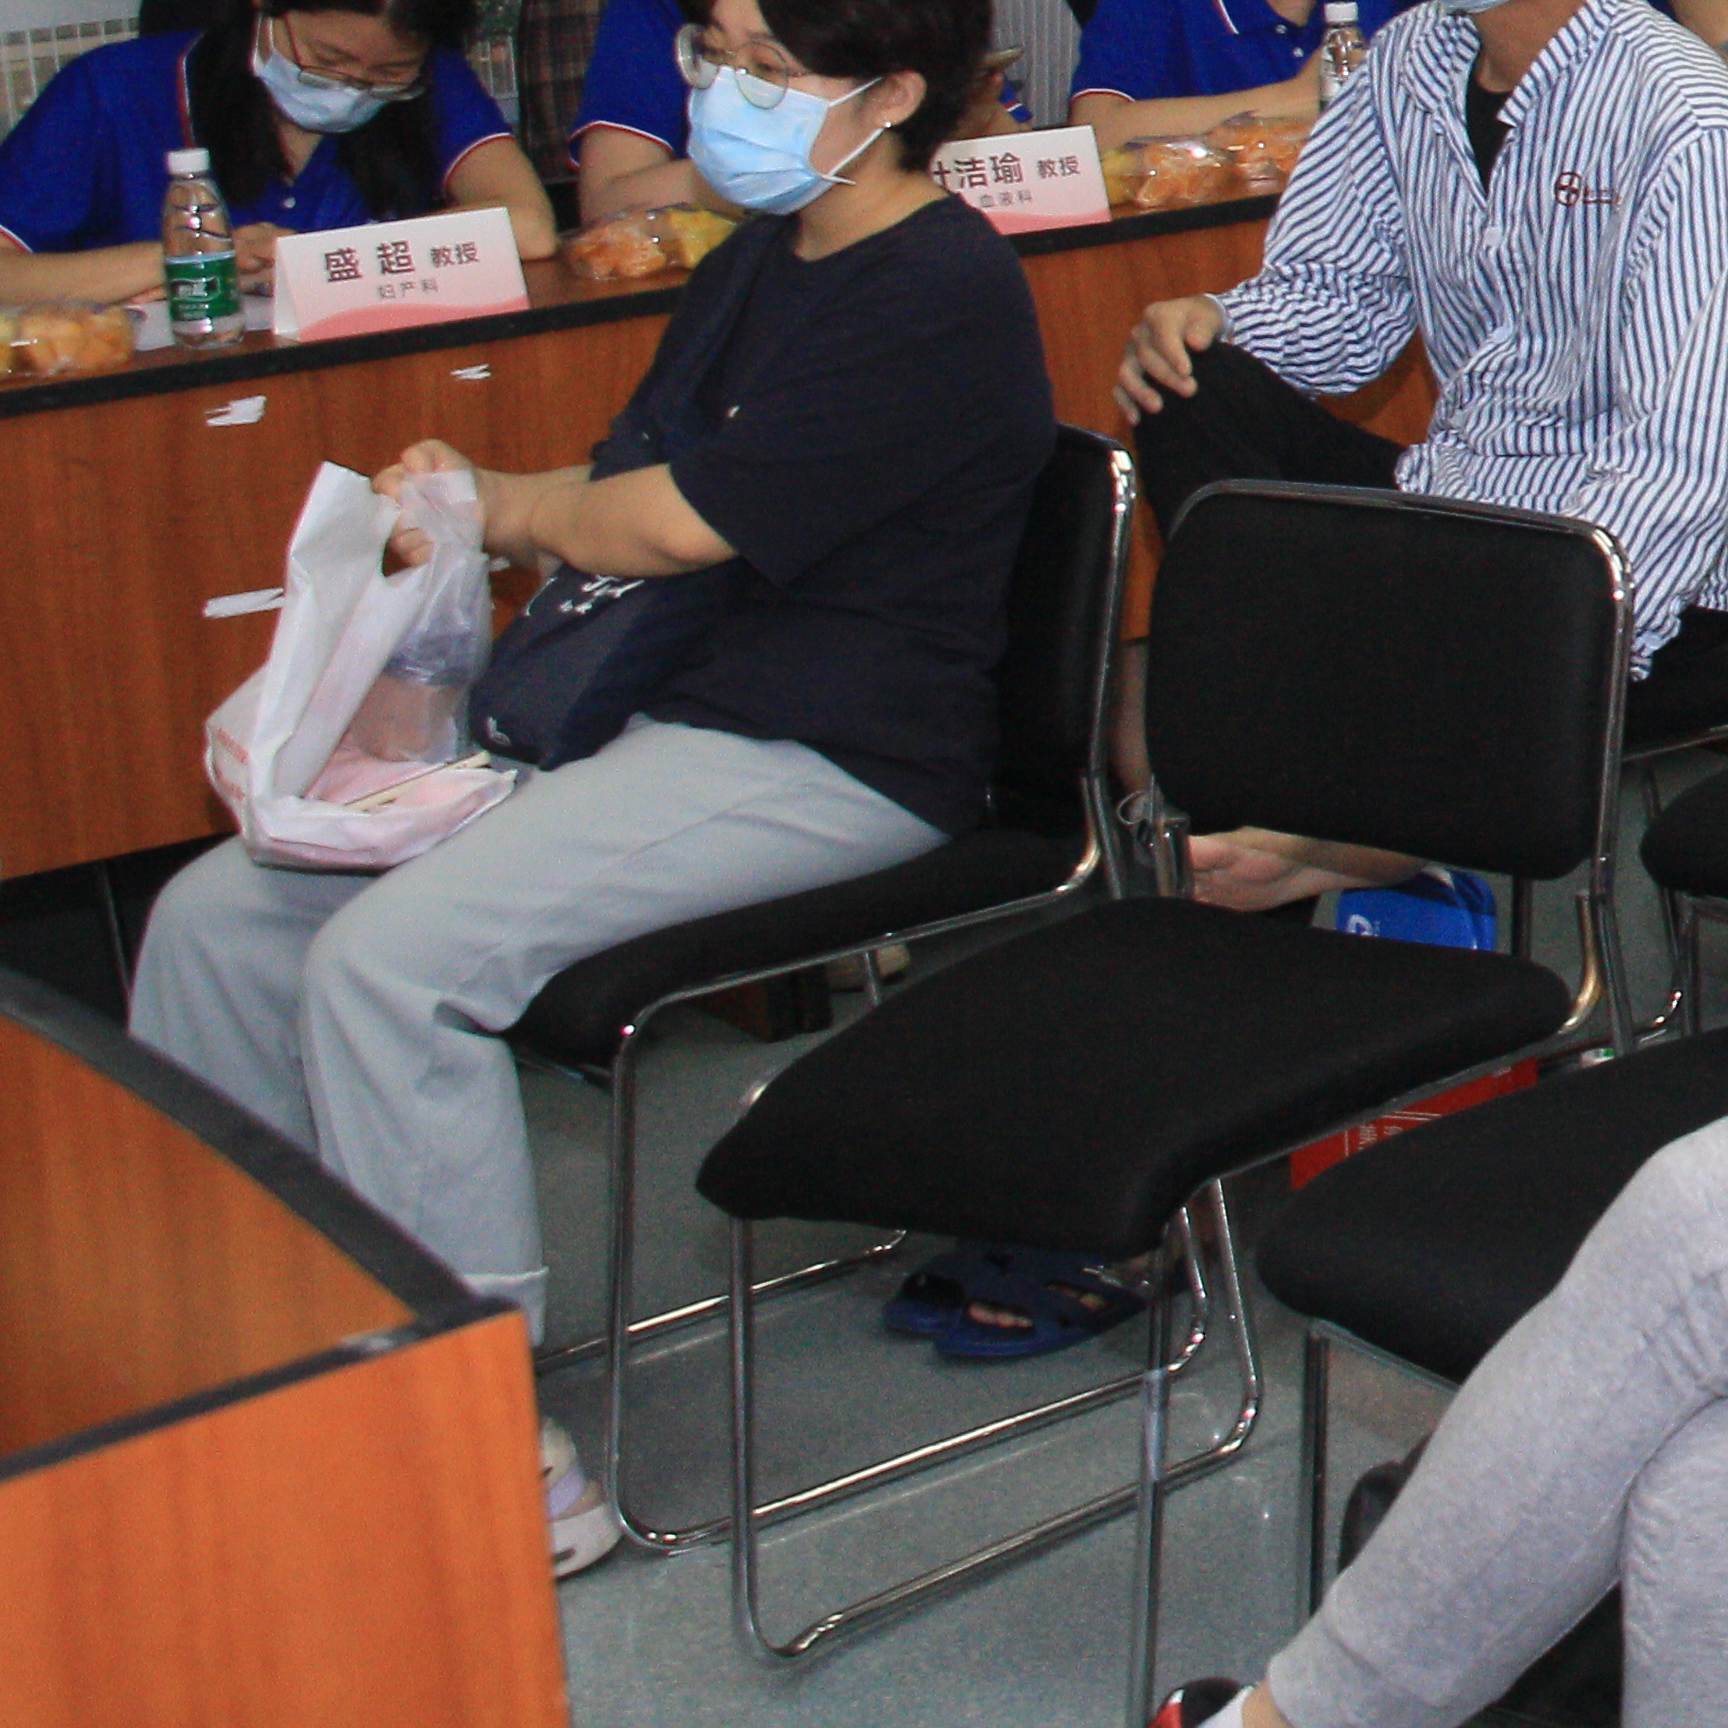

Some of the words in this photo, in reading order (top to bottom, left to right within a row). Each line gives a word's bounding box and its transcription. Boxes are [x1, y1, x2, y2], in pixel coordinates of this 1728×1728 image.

[1036, 154, 1081, 179] 教授
[429, 241, 481, 269] 教授
[377, 277, 440, 299] 妇产科
